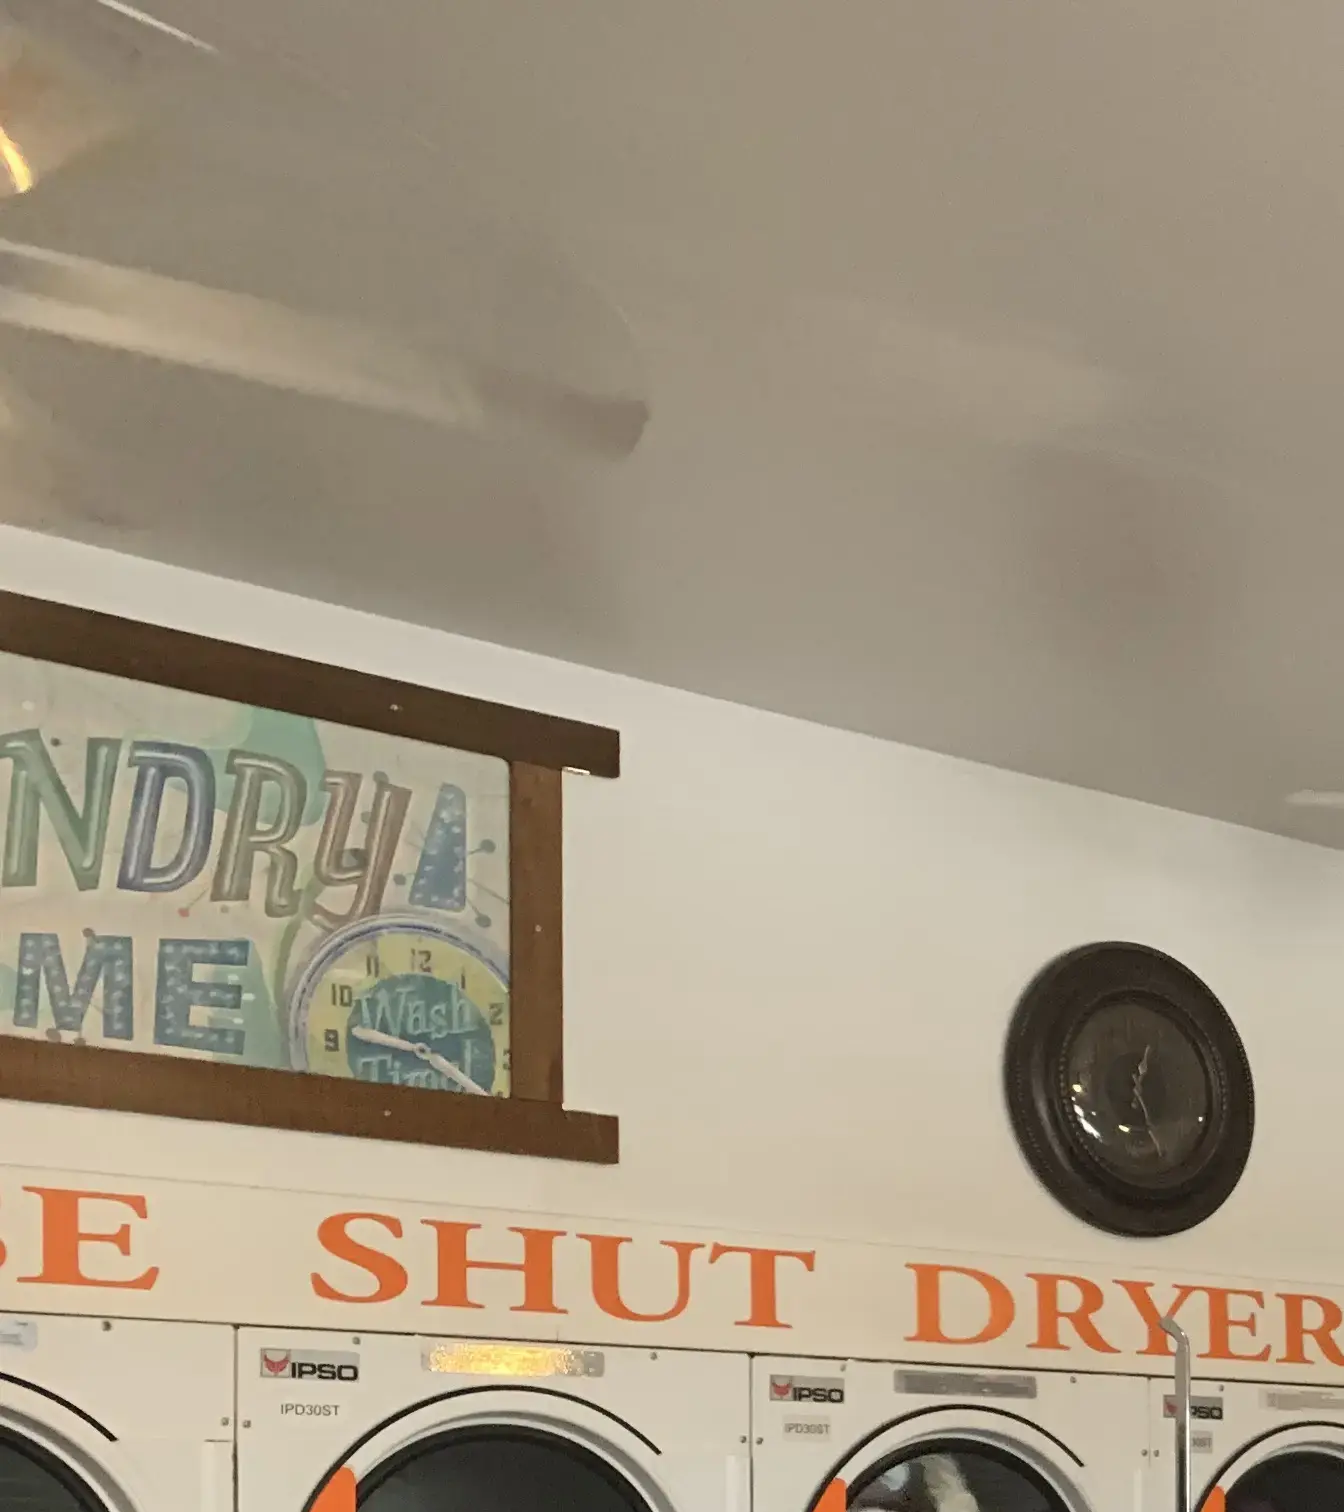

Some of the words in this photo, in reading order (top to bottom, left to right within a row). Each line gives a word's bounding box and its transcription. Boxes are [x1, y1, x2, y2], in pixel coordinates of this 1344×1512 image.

[331, 983, 353, 1007] 10
[360, 985, 480, 1038] Wash
[0, 1186, 159, 1291] E
[311, 1212, 815, 1328] SHUT
[290, 1361, 359, 1382] IPSO
[793, 1386, 845, 1403] IPSO
[280, 1403, 340, 1416] IPD30ST
